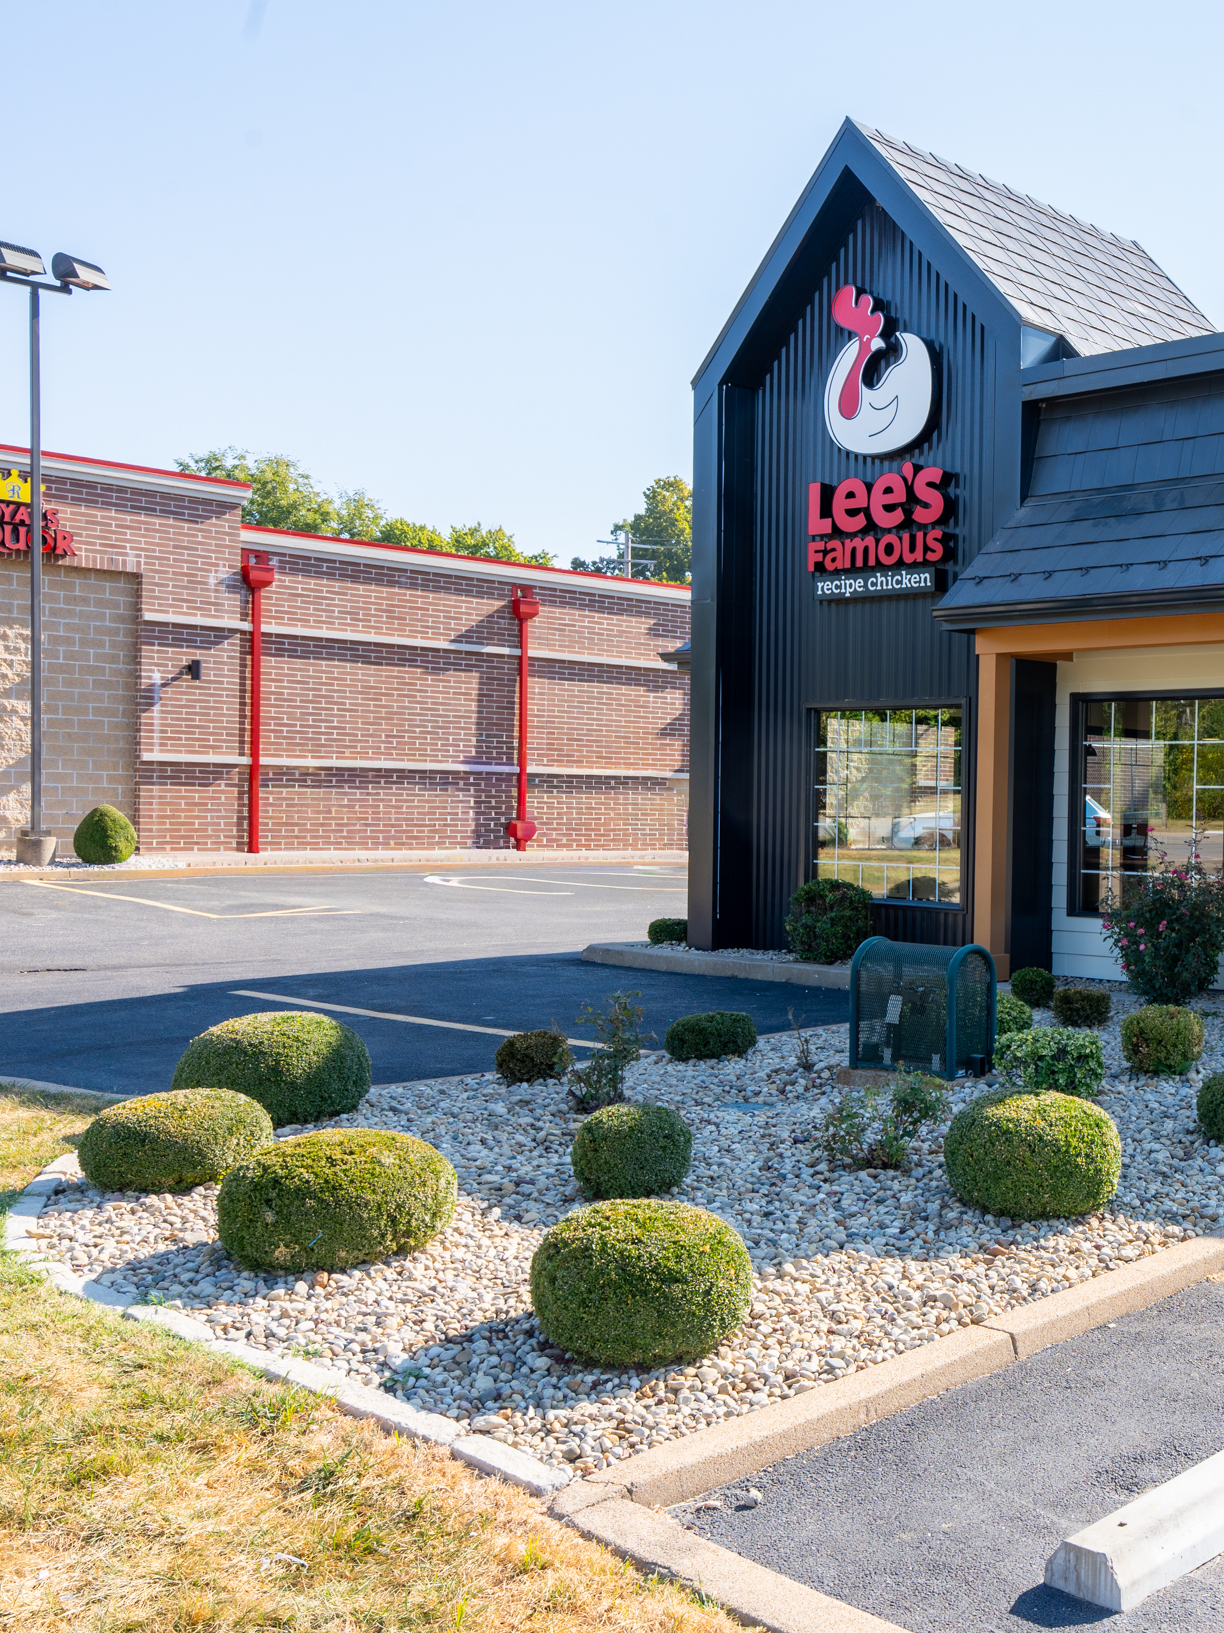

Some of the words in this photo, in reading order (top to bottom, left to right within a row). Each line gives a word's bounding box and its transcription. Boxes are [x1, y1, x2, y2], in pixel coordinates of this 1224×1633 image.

[808, 460, 944, 536] Lee's
[0, 503, 59, 527] YAS
[0, 524, 78, 556] UOR
[807, 529, 944, 572] Famous
[816, 576, 864, 596] recipe
[868, 571, 931, 591] chicken
